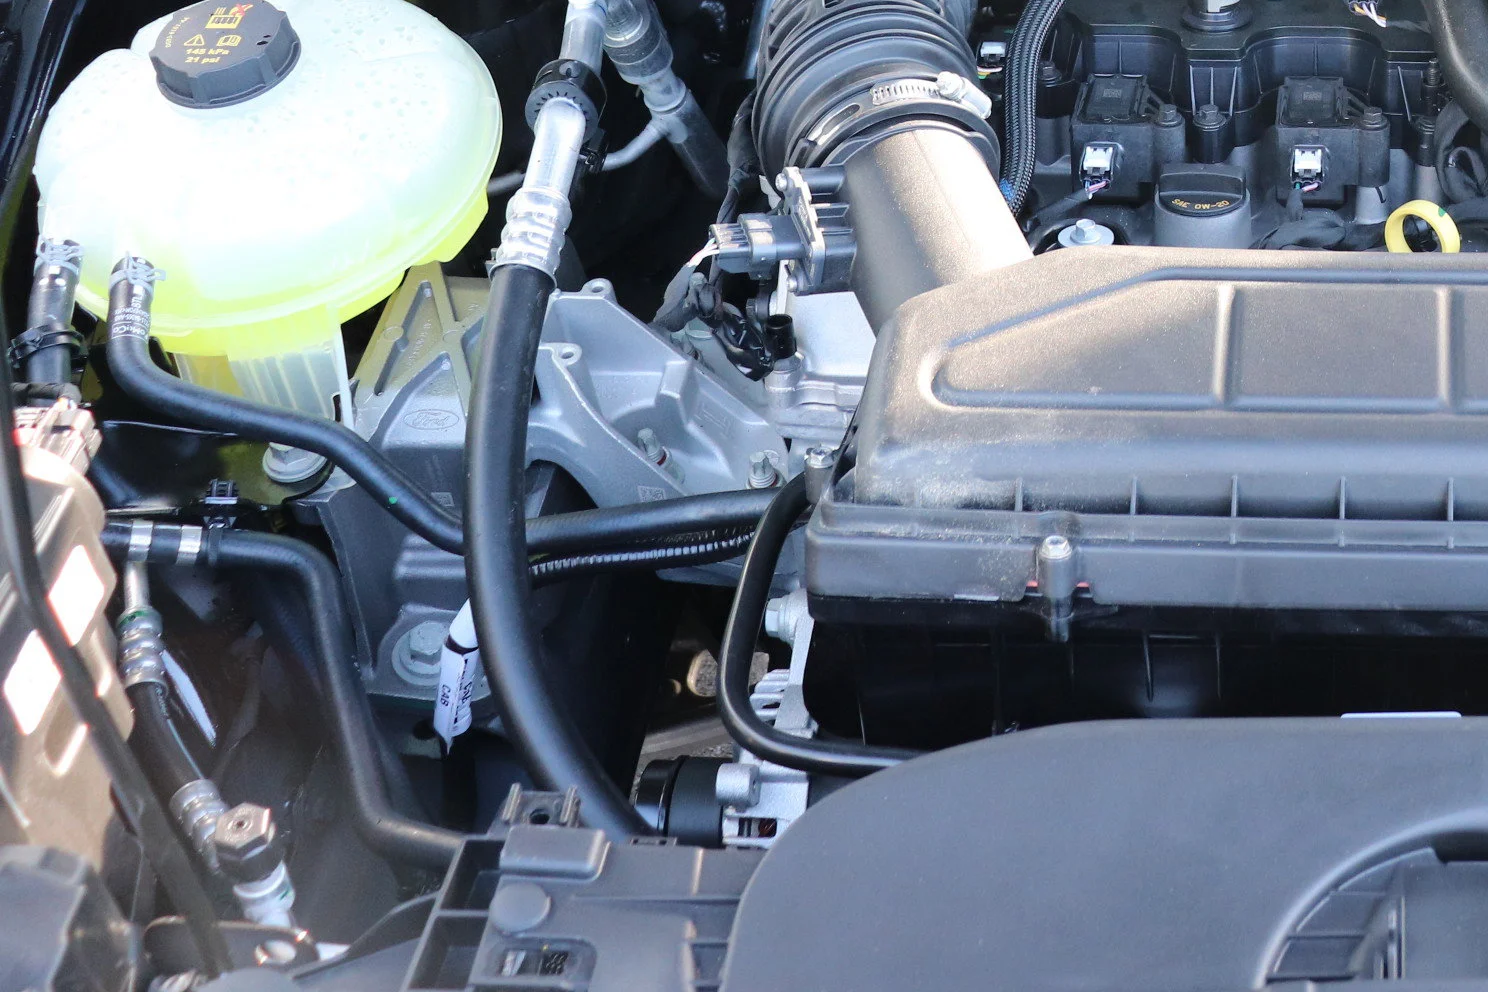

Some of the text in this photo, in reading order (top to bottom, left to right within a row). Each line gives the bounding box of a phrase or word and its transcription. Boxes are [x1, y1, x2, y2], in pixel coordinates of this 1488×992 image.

[200, 56, 220, 64] psi
[1171, 198, 1190, 208] SAE
[411, 413, 450, 427] Ford
[440, 684, 451, 707] CAB
